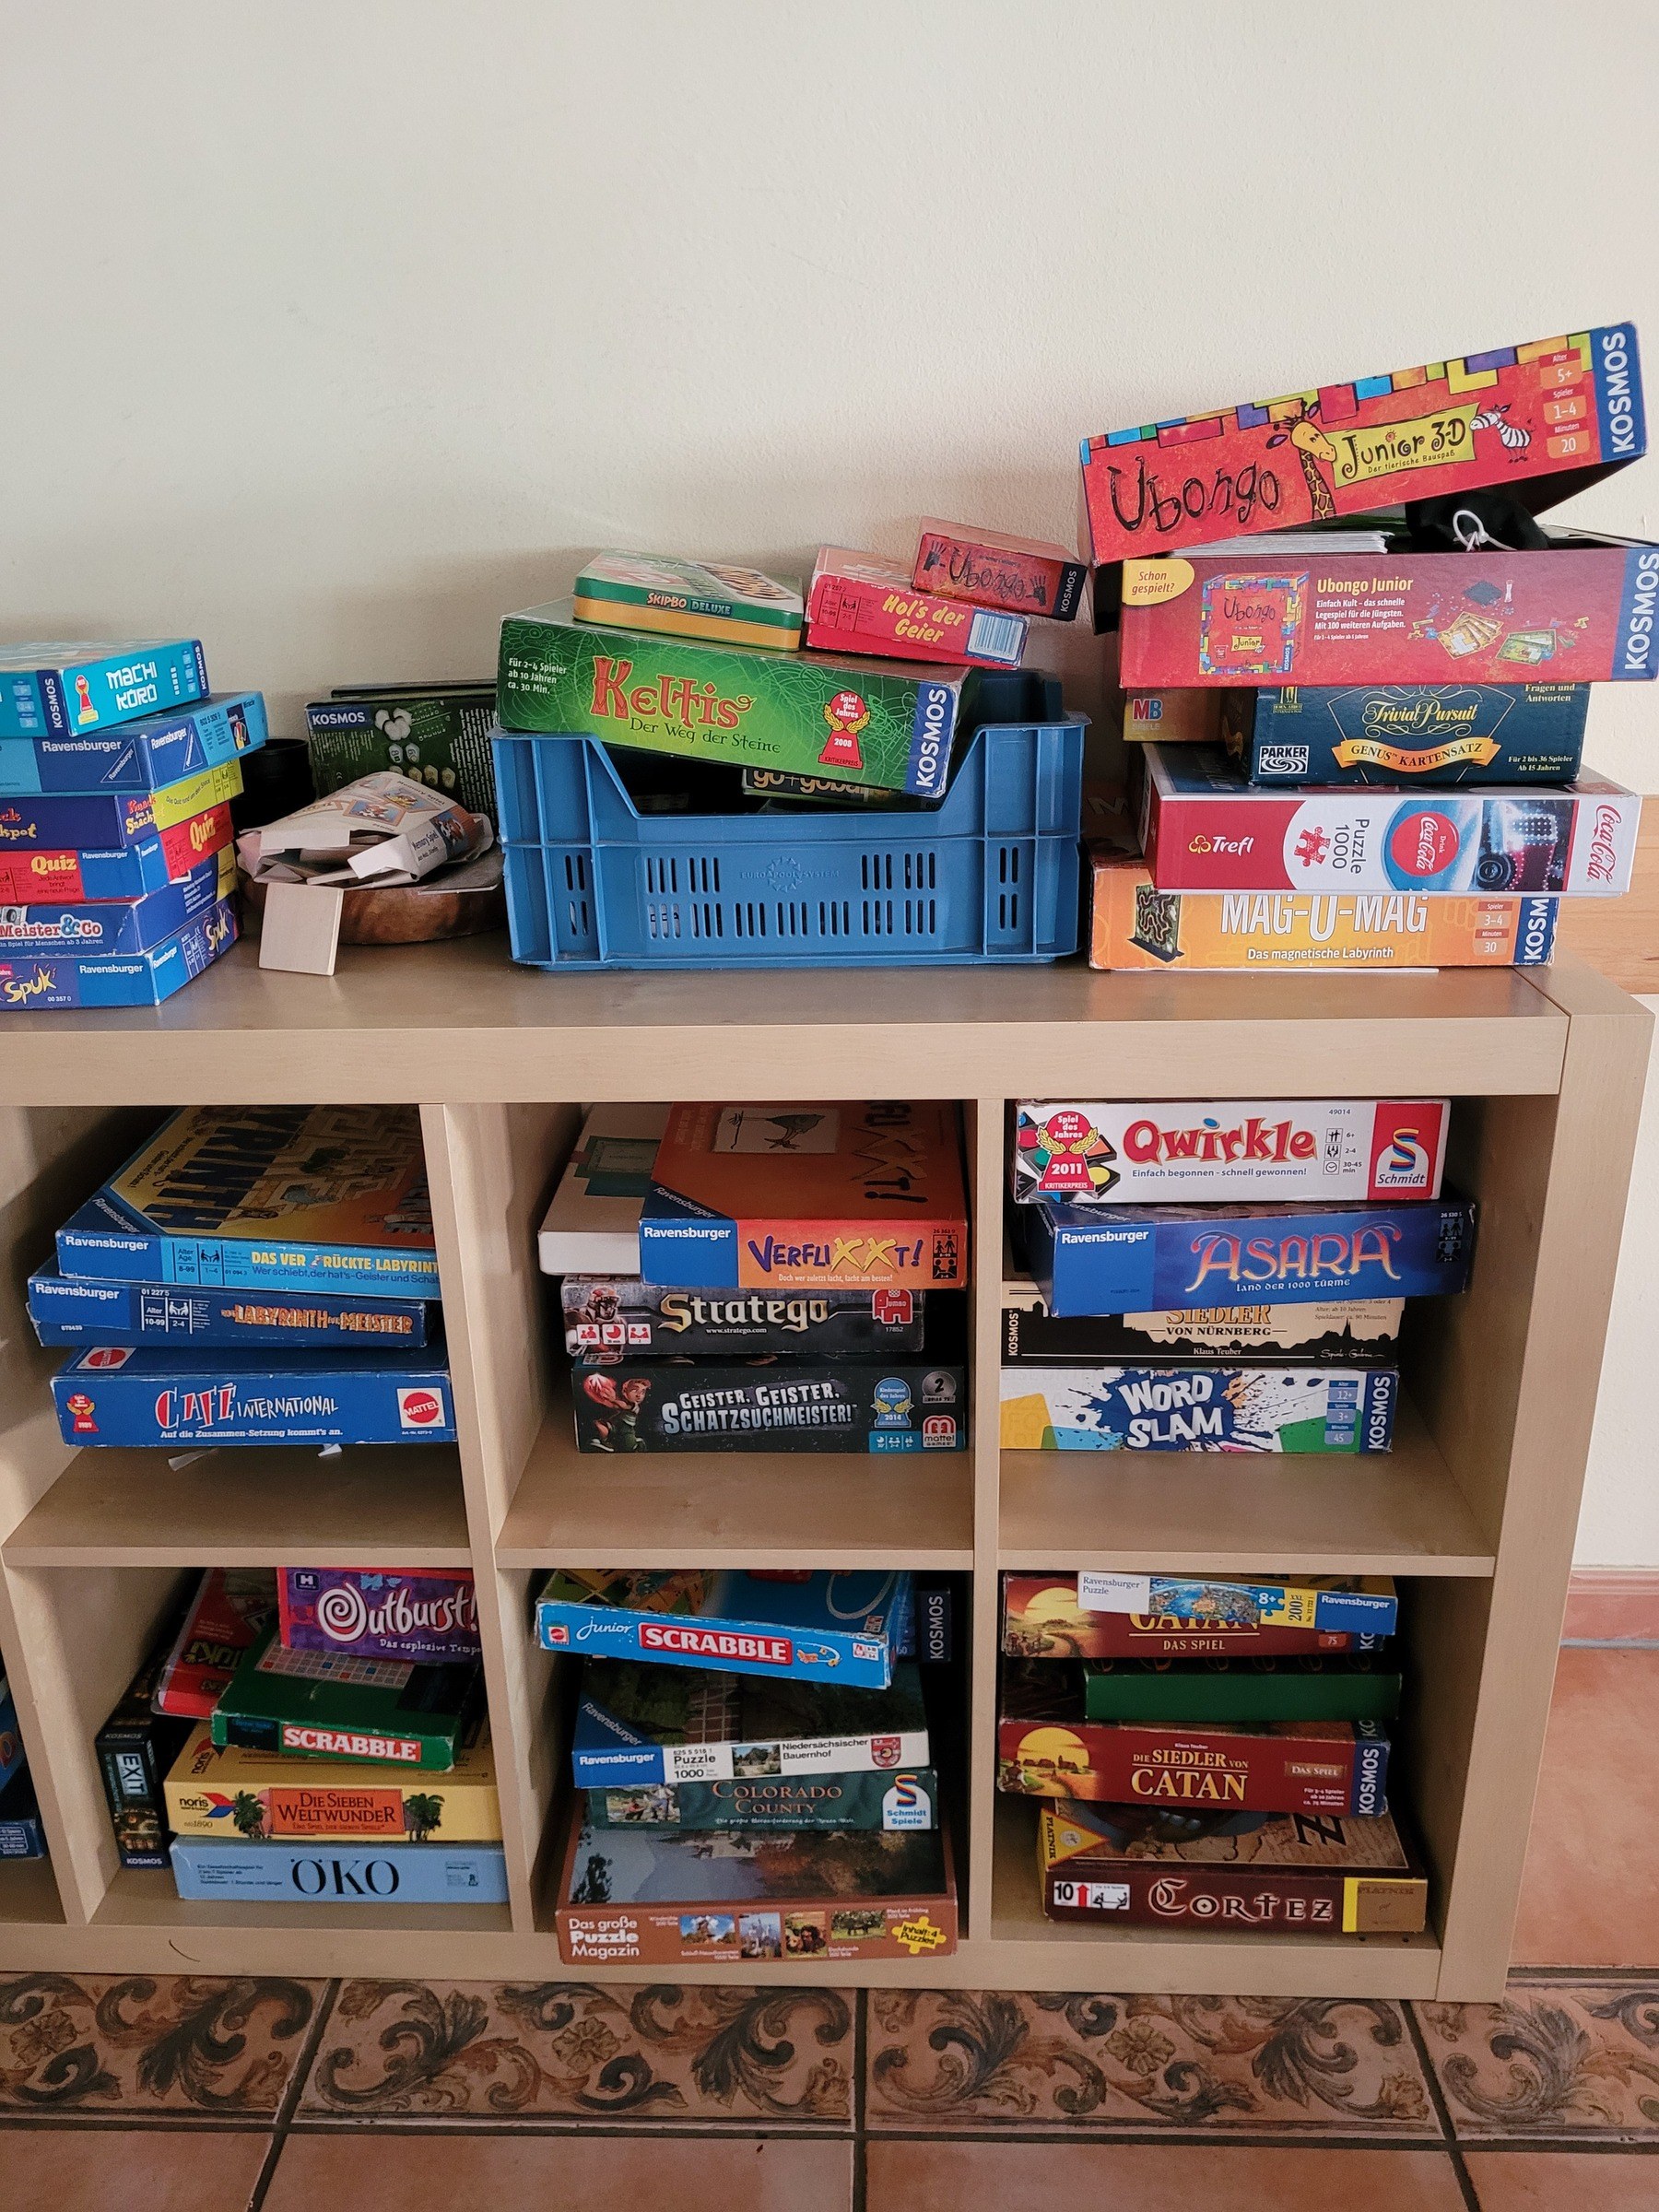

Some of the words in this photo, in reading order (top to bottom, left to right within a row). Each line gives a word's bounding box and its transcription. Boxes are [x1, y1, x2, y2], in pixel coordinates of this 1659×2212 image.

[1558, 369, 1573, 382] 5+
[1553, 387, 1574, 397] Spieler
[1603, 331, 1635, 453] KOSMOS
[1554, 422, 1580, 433] Minuten
[1341, 430, 1426, 479] Junior
[1431, 418, 1466, 452] 3-D
[1561, 439, 1576, 453] 20
[1368, 464, 1382, 474] Der
[1383, 457, 1420, 472] tierische
[1422, 450, 1456, 465] Bauspaß
[1106, 455, 1280, 532] Ubongo
[1138, 571, 1167, 582] Schon
[1060, 569, 1077, 613] KOSMOS
[1131, 582, 1175, 595] gespielt?
[1317, 578, 1369, 596] Ubongo
[1371, 576, 1414, 594] Junior
[646, 592, 688, 608] SKIPBO
[691, 600, 731, 616] DELUXE
[882, 594, 927, 619] Hol's
[933, 601, 966, 627] der
[1316, 599, 1341, 608] Einfach
[1343, 598, 1358, 607] Kult
[1364, 598, 1376, 607] das
[1377, 597, 1406, 606] schnelle
[1625, 552, 1659, 670] KOSMOS
[1315, 609, 1347, 621] Legespiel
[1348, 609, 1359, 618] für
[1360, 609, 1371, 618] die
[1371, 607, 1404, 619] Jüngsten.
[895, 618, 945, 644] Geier
[1314, 620, 1326, 630] Mit
[1327, 620, 1339, 629] 100
[1340, 620, 1369, 630] weiteren
[1370, 619, 1406, 630] Aufgaben.
[194, 645, 207, 690] KOSMOS
[508, 657, 522, 668] Für
[524, 662, 538, 671] 2-4
[539, 663, 567, 675] Spieler
[508, 669, 519, 678] ab
[530, 671, 558, 684] Jahren
[508, 682, 519, 690] ca.
[520, 683, 531, 692] 30
[532, 684, 551, 695] Min.
[590, 655, 757, 730] Keltis
[1524, 684, 1555, 694] Fragen
[1558, 683, 1575, 692] und
[44, 677, 64, 728] KOSMOS
[840, 693, 858, 705] Spiel
[843, 701, 856, 712] des
[1525, 693, 1571, 703] Antworten
[312, 712, 365, 725] KOSMOS
[835, 706, 859, 720] Jahres
[1133, 699, 1163, 721] MB
[629, 717, 659, 734] Der
[665, 722, 696, 744] Weg
[702, 731, 728, 745] der
[732, 734, 781, 754] Steine
[916, 688, 947, 789] KOSMOS
[41, 740, 122, 753] Ravensburger
[1260, 746, 1308, 758] PARKER
[1399, 742, 1483, 767] KARTENSATZ
[1508, 755, 1521, 764] Für
[1527, 755, 1538, 763] bis
[1538, 755, 1547, 763] 36
[1548, 754, 1573, 764] Spieler
[1517, 764, 1526, 772] Ab
[1527, 764, 1536, 772] 15
[1537, 764, 1560, 772] Jahren
[190, 813, 216, 852] Quiz
[1211, 835, 1254, 857] Trefl
[1332, 824, 1349, 869] 1000
[1350, 818, 1371, 875] Puzzle
[82, 850, 128, 861] Ravensburger
[30, 854, 77, 876] Quiz
[1487, 902, 1504, 912] Spieler
[1524, 899, 1550, 960] KOSM
[1247, 948, 1269, 959] Das
[1271, 947, 1340, 961] magnetische
[1343, 947, 1394, 961] Labyrinth
[1484, 942, 1497, 953] 30
[79, 964, 144, 975] Ravensburger
[1057, 1114, 1079, 1124] Spiel
[1062, 1122, 1078, 1131] des
[1053, 1130, 1083, 1139] Jahres
[1123, 1117, 1318, 1166] Qwirkle
[1051, 1163, 1082, 1175] 2011
[1132, 1170, 1166, 1178] Einfach
[1168, 1169, 1215, 1179] begonnen
[1221, 1169, 1253, 1177] schnell
[1255, 1168, 1307, 1178] gewonnen!
[1044, 1182, 1088, 1190] KRITIKERPREIS
[1377, 1173, 1426, 1184] Schmidt
[653, 1186, 716, 1218] Ravensburger
[644, 1228, 731, 1241] Ravensburger
[1062, 1230, 1149, 1244] Ravensburger
[65, 1236, 148, 1251] Ravensburger
[252, 1251, 276, 1265] DAS
[376, 1258, 439, 1274] LABYRINT
[747, 1235, 924, 1273] VERFLIXXT!
[1184, 1221, 1402, 1292] ASARA
[253, 1266, 271, 1276] Wer
[391, 1274, 409, 1283] und
[35, 1283, 119, 1300] Ravensburger
[235, 1304, 329, 1329] LABYRINTH
[339, 1312, 414, 1334] MEISTER
[658, 1293, 828, 1334] Stratego
[1008, 1312, 1019, 1357] KOSMOS
[1166, 1326, 1194, 1335] VON
[1196, 1325, 1271, 1336] NÜRNBERG
[1193, 1347, 1215, 1356] Klaus
[1216, 1347, 1242, 1356] Teuber
[1118, 1374, 1213, 1416] WORD
[155, 1382, 238, 1430] CAFÉ
[237, 1395, 339, 1419] INTERNATIONAL
[404, 1401, 439, 1418] MATTEL
[1369, 1376, 1390, 1450] KOSMOS
[662, 1402, 853, 1434] SCHATZSUCHMEISTER!
[160, 1430, 180, 1439] Auf
[182, 1430, 194, 1439] die
[195, 1430, 285, 1440] Zusammen-Setzung
[287, 1429, 327, 1437] kommt's
[1127, 1406, 1223, 1448] SLAM
[1082, 1586, 1110, 1596] Puzzle
[1258, 1593, 1277, 1605] 8+
[1321, 1594, 1390, 1610] Ravensburger
[318, 1582, 477, 1643] Outburst!
[929, 1595, 944, 1660] KOSMOS
[380, 1639, 397, 1649] Das
[400, 1641, 446, 1653] explosive
[645, 1627, 787, 1661] SCRABBLE
[1163, 1640, 1187, 1651] DAS
[1190, 1639, 1226, 1651] SPIEL
[283, 1726, 418, 1760] SCRABBLE
[782, 1738, 869, 1751] Niedersächsischer
[579, 1753, 655, 1766] Ravensburger
[674, 1754, 716, 1766] Puzzle
[782, 1750, 832, 1760] Bauernhof
[1133, 1753, 1150, 1763] DIE
[1152, 1749, 1227, 1768] SIEDLER
[1229, 1760, 1249, 1769] VON
[123, 1755, 146, 1793] EXIT
[674, 1769, 705, 1779] 1000
[1359, 1748, 1380, 1816] KOSMOS
[712, 1780, 843, 1799] COLORADO
[1131, 1768, 1248, 1802] CATAN
[179, 1796, 209, 1807] noris
[300, 1793, 324, 1808] DIE
[327, 1793, 374, 1809] SIEBEN
[735, 1798, 818, 1815] COUNTY
[277, 1805, 397, 1823] WELTWUNDER
[887, 1808, 927, 1818] Schmidt
[890, 1818, 924, 1826] Spiele
[126, 1857, 163, 1865] KOSMOS
[290, 1858, 400, 1895] ÖKO
[1054, 1883, 1075, 1901] 10
[1147, 1877, 1333, 1924] CORTEZ
[568, 1918, 595, 1930] Das
[597, 1915, 638, 1932] große
[570, 1929, 640, 1945] Puzzle
[571, 1943, 641, 1960] Magazin
